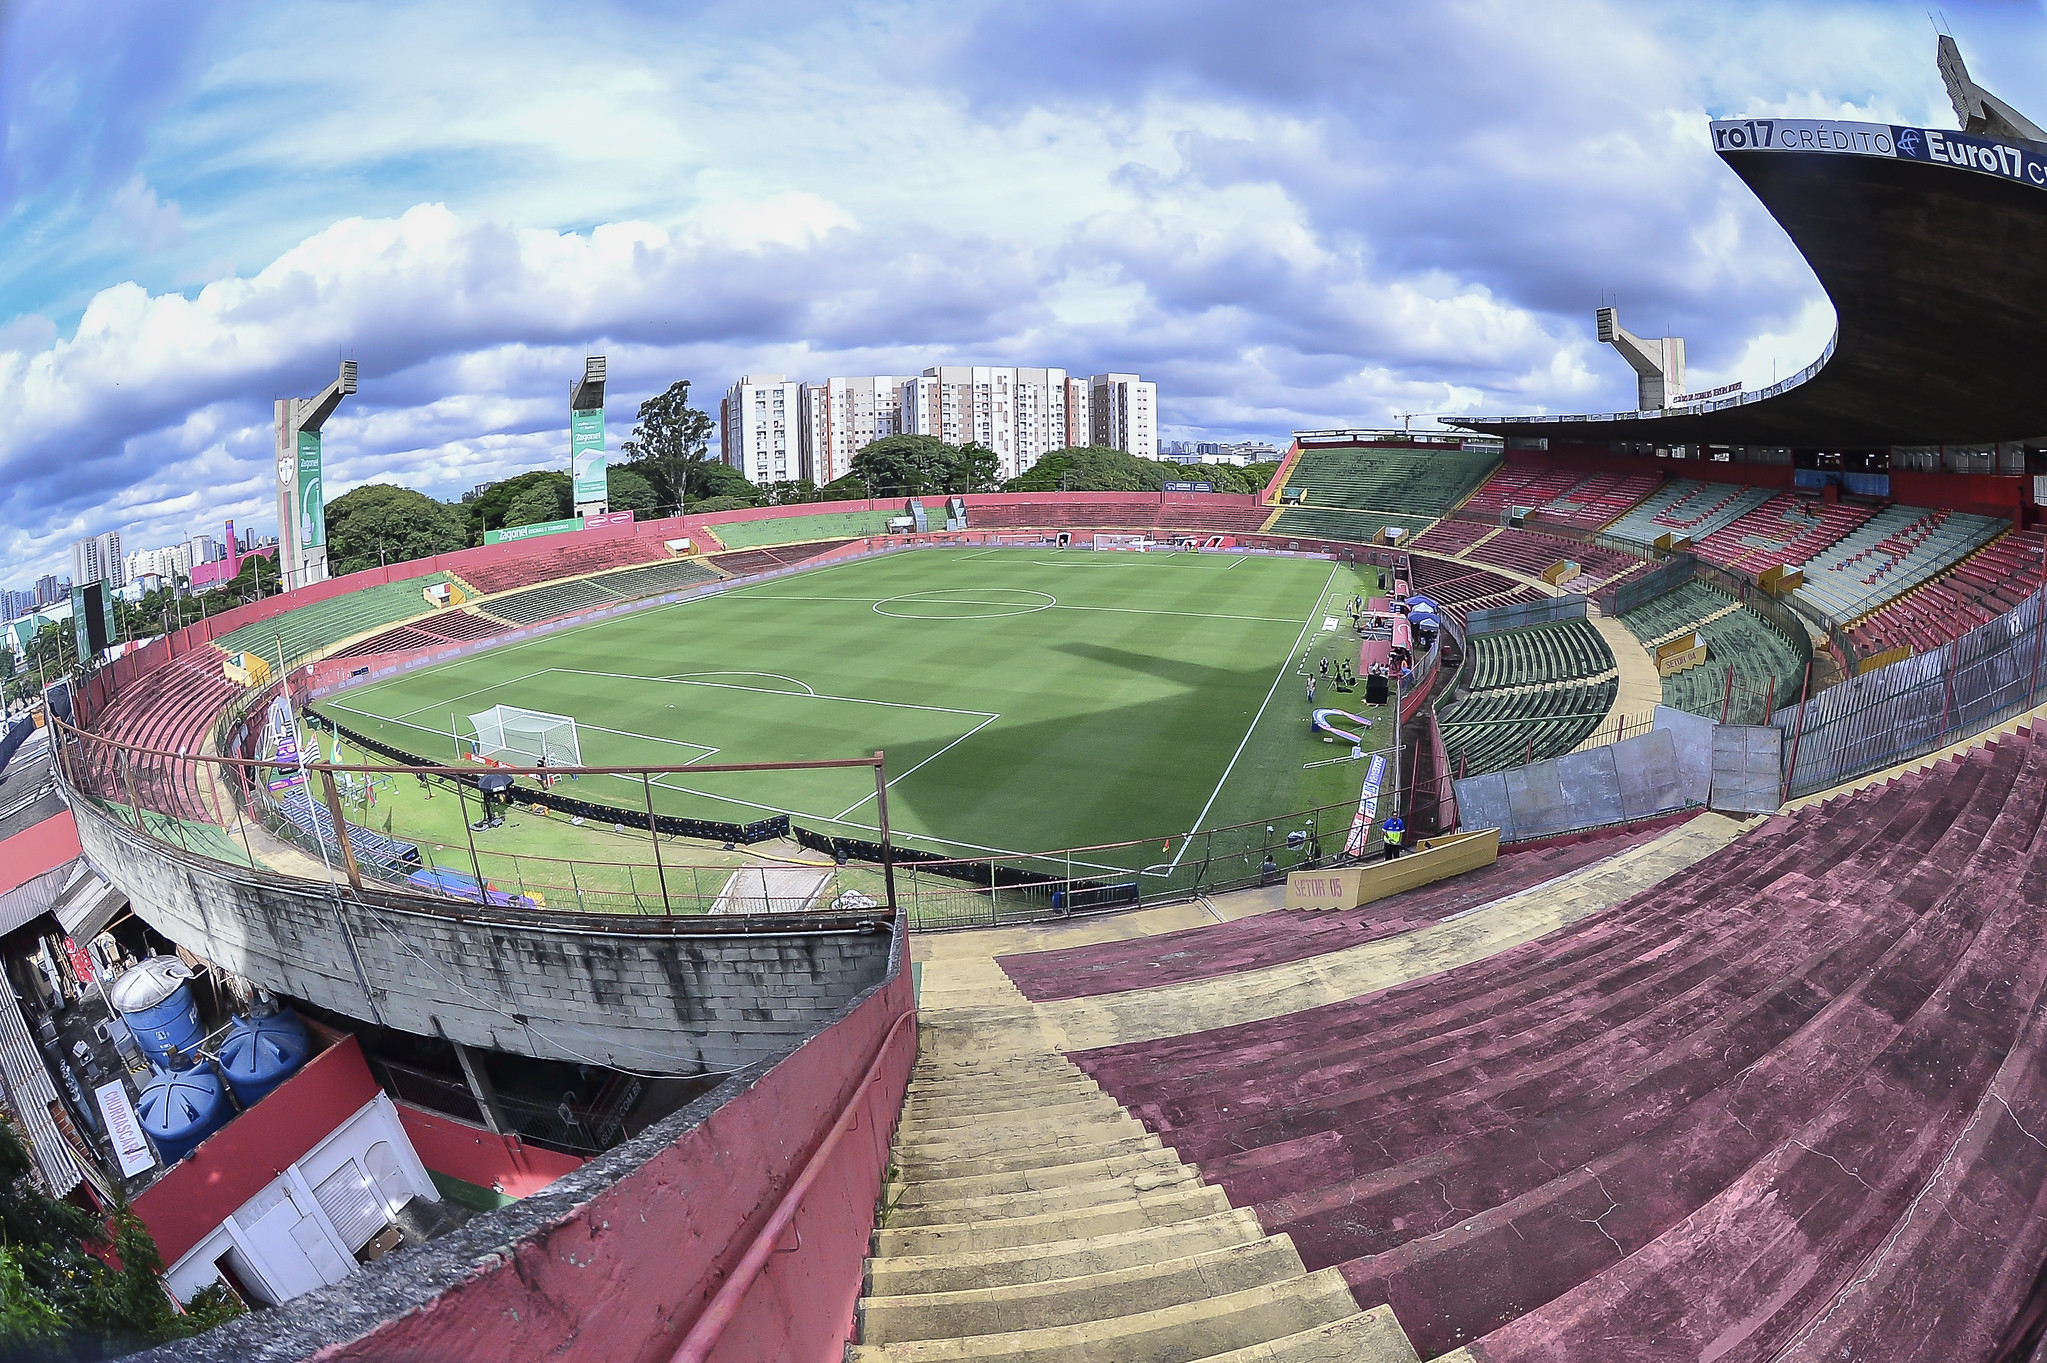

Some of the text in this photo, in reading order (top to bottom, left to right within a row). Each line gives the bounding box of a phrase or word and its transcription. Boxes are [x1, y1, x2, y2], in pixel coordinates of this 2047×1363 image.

[1780, 124, 1892, 154] CRÉDITO
[1924, 131, 2022, 178] Euro17
[498, 527, 528, 541] Zagonel
[1294, 878, 1343, 898] SETOR 05
[103, 1090, 144, 1164] CHURRASCARA
